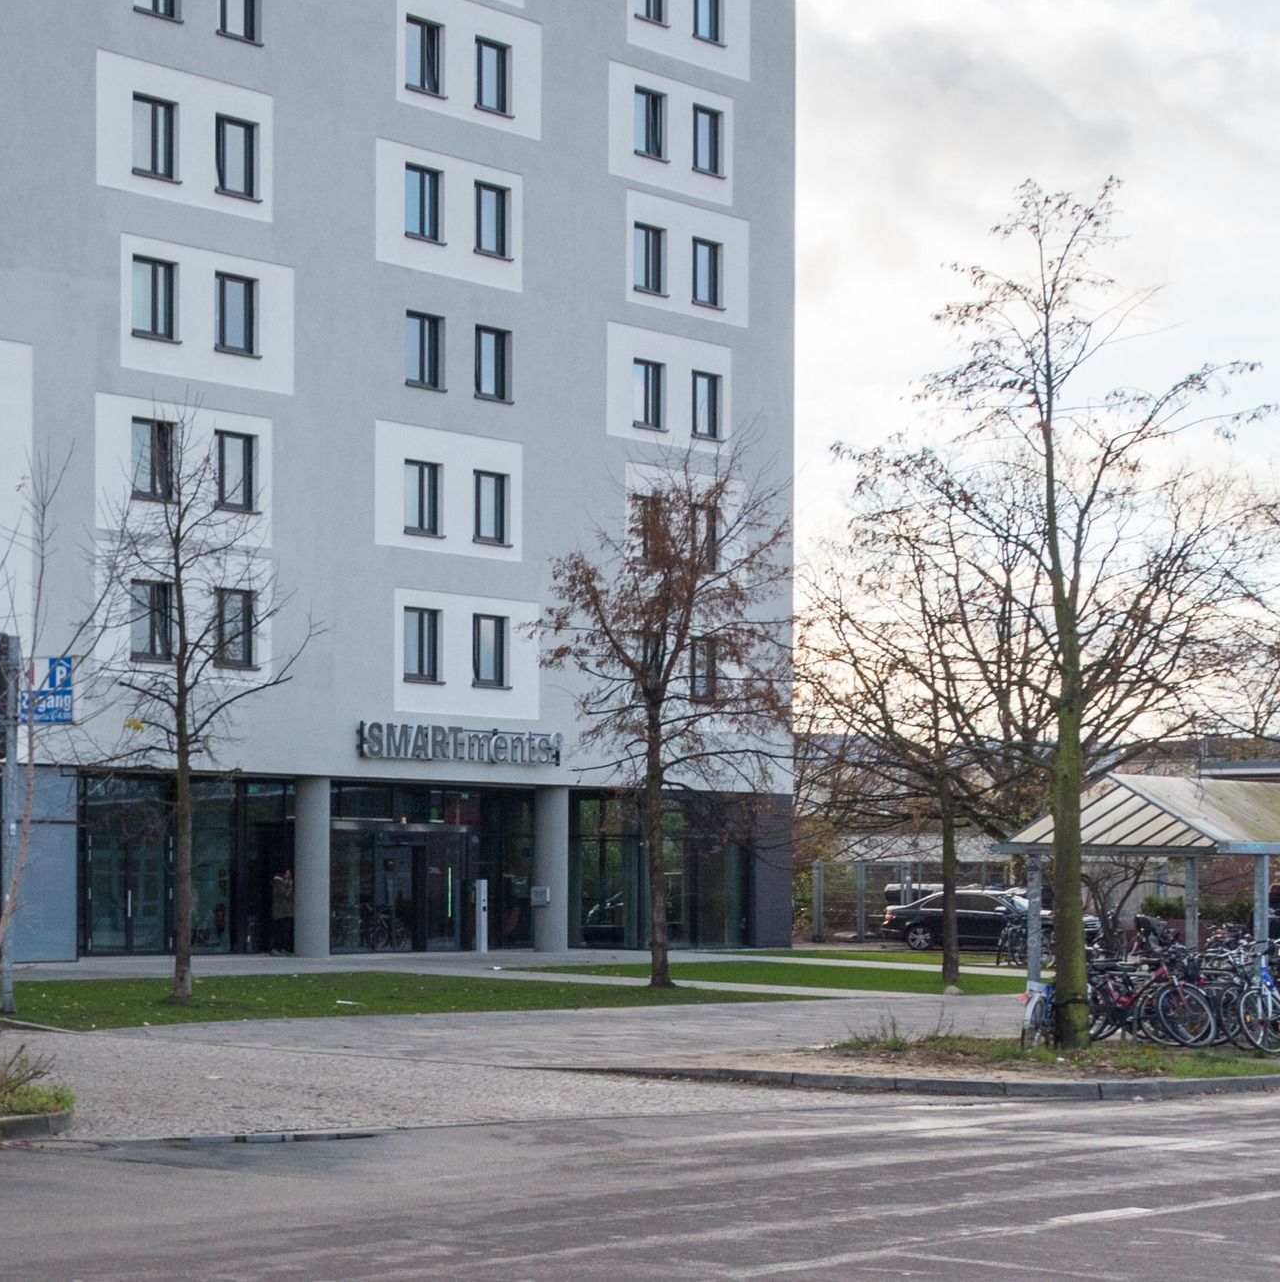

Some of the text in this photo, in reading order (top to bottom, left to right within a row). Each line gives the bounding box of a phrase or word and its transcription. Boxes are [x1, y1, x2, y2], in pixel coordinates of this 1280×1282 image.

[55, 666, 67, 687] P
[21, 692, 72, 712] Zgang
[365, 722, 551, 764] SMARTments
